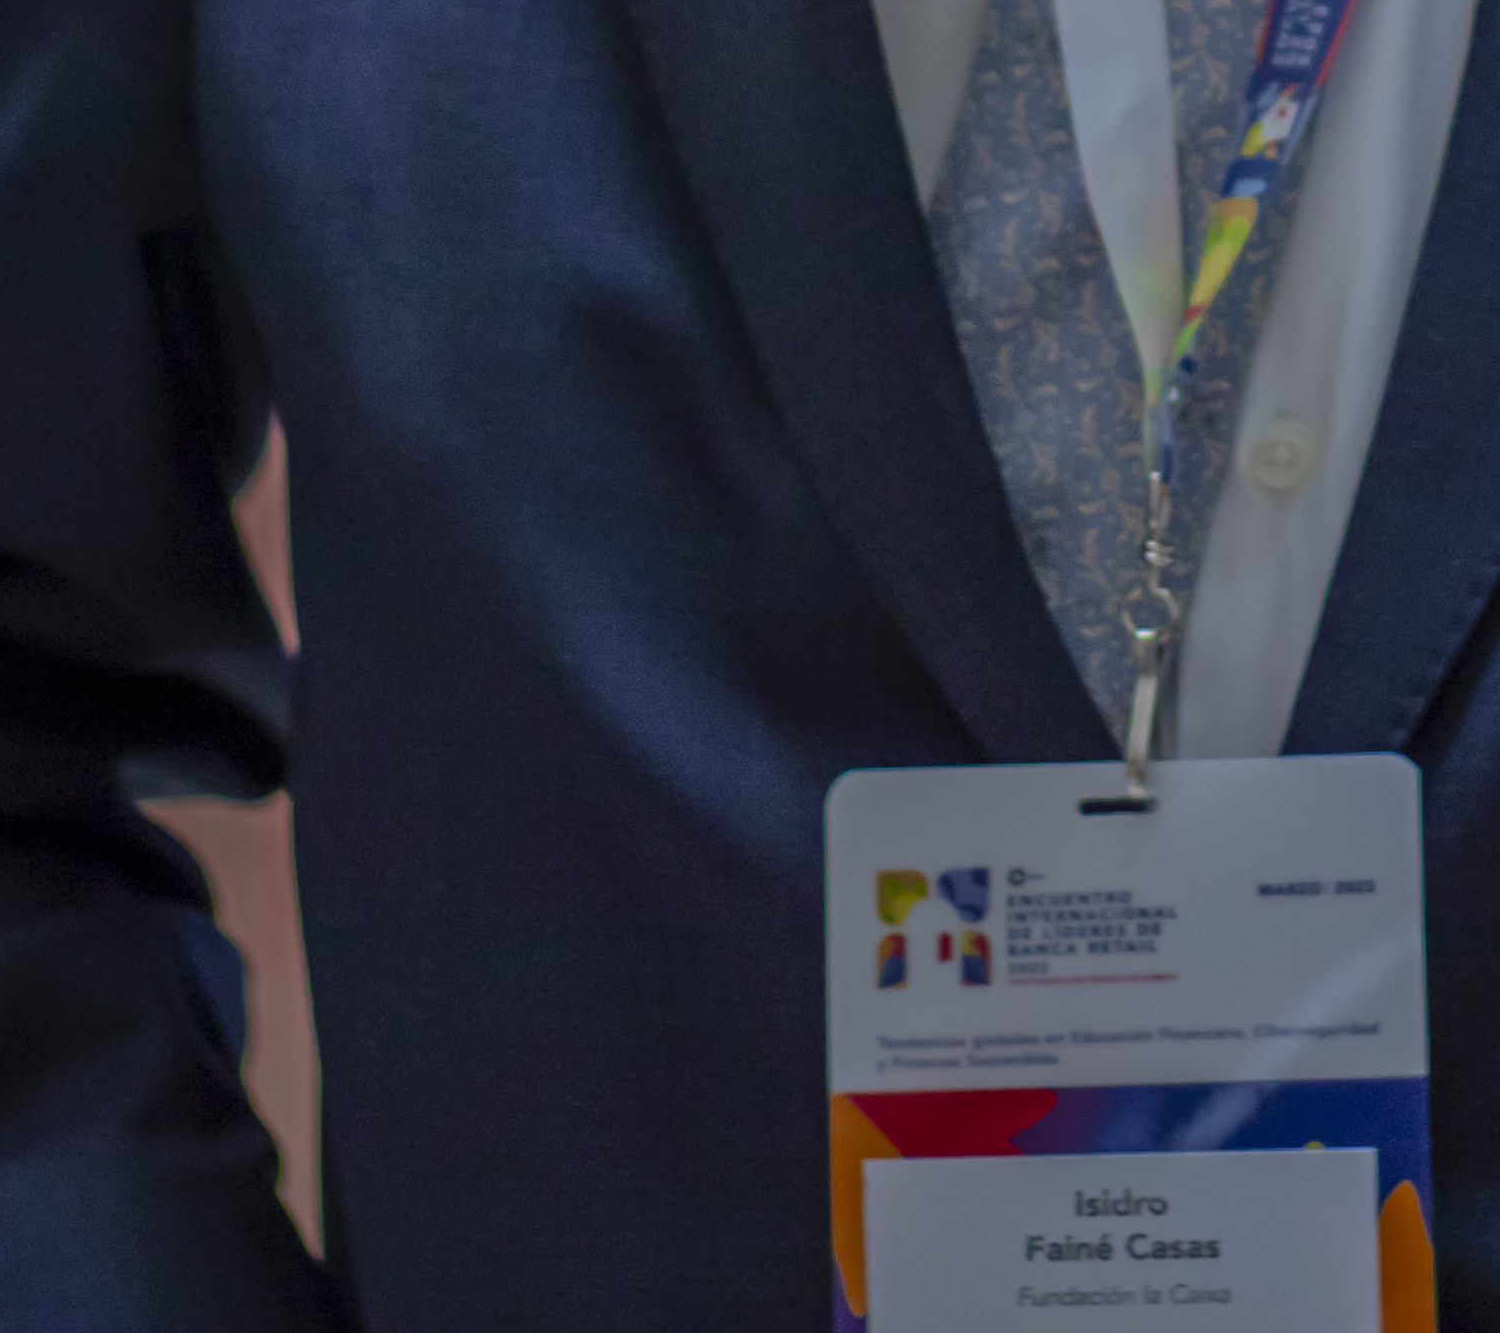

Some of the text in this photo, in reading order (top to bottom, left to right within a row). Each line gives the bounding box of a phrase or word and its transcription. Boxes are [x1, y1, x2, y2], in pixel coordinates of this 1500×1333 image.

[1258, 883, 1322, 896] MARZO
[1007, 891, 1132, 908] ENCUENTRO
[1007, 906, 1177, 923] INTERNACIONAL
[1007, 927, 1031, 940] DE
[1137, 922, 1161, 936] DE
[1007, 939, 1156, 957] BANCA RETAIL
[1075, 1188, 1169, 1217] Isidro
[1025, 1232, 1221, 1262] Fainé Casas
[1017, 1282, 1232, 1307] Fundación la Caixa
